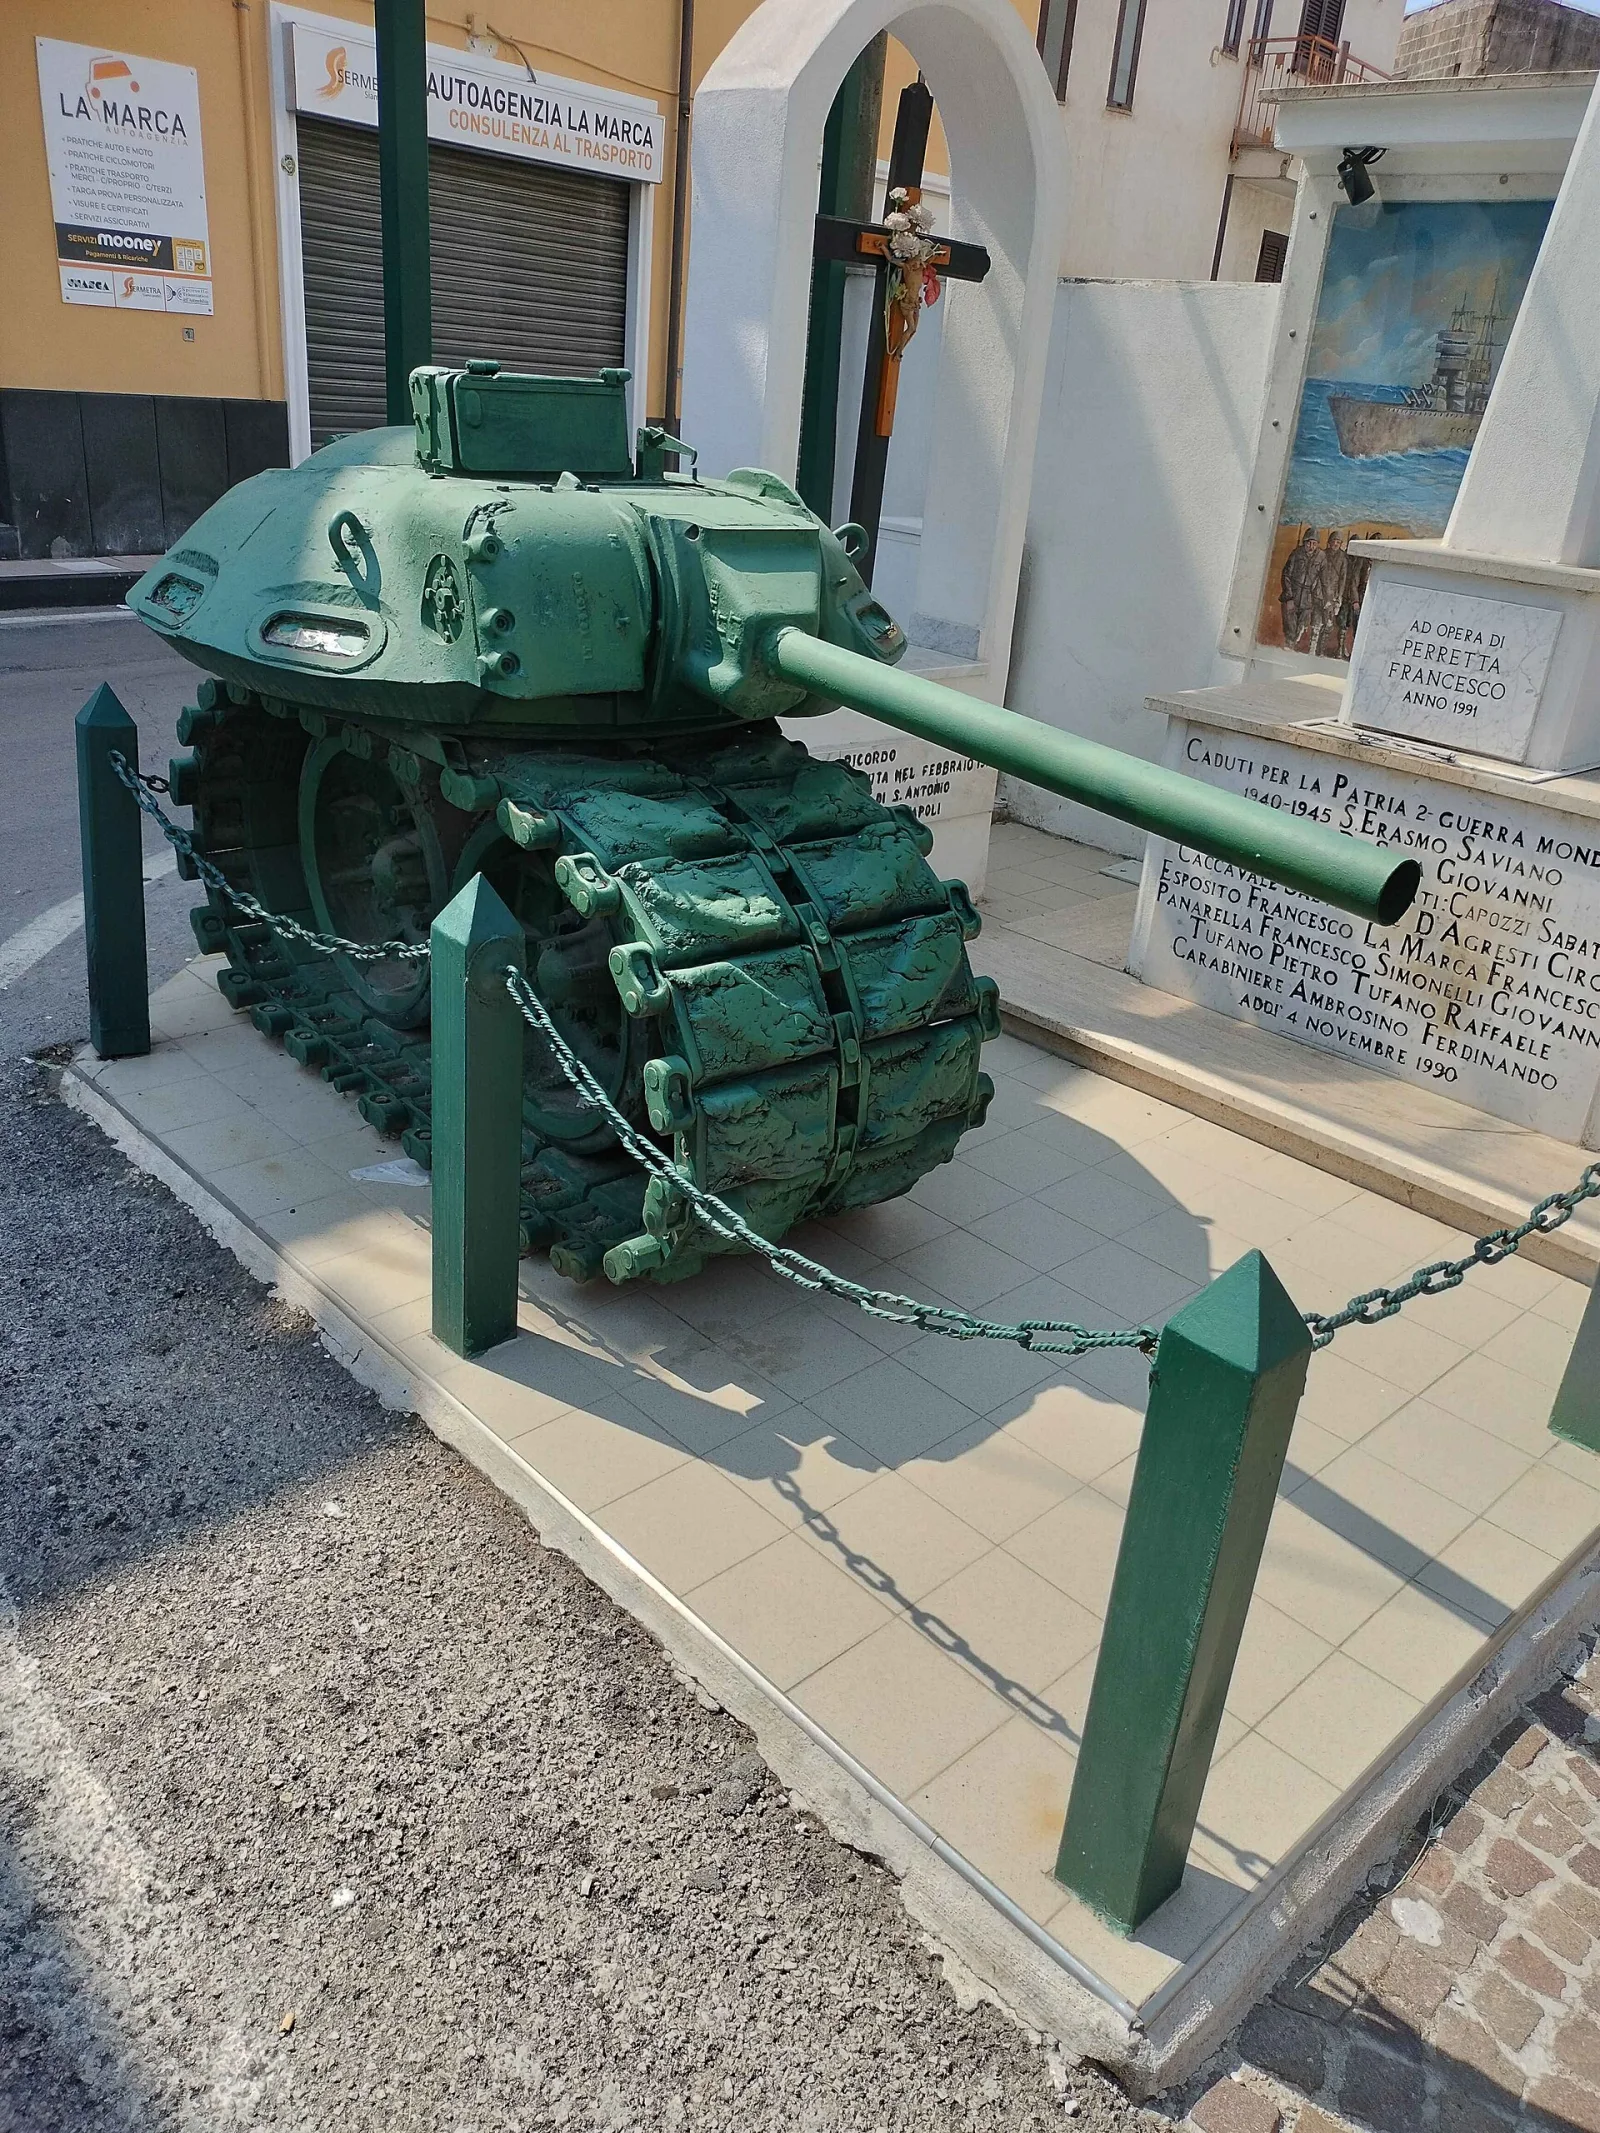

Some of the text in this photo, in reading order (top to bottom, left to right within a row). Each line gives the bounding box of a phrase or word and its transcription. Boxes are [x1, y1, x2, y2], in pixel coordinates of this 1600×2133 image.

[60, 92, 187, 138] LA MARCA
[427, 72, 654, 149] AUTOAGENZIA LA MARCA
[66, 135, 154, 157] PRATICHE AUTO E MOTO
[105, 126, 189, 147] AUTOAGENZIA
[449, 108, 653, 171] CONSULENZA AL TRASPORTO
[68, 149, 155, 170] PRATICHE CICLOMOTORI
[69, 163, 150, 183] PRATICHE TRASPORTO
[71, 173, 95, 184] MERCI
[100, 177, 141, 190] C/PROPRIO
[145, 183, 173, 194] C/TERZI
[71, 185, 184, 208] TARGA PROVA PERSONALIZZATA
[72, 199, 100, 210] VISURE
[106, 204, 149, 216] CERTIFICATI
[74, 212, 150, 229] SERVIZI ASSICURATIVI
[67, 234, 97, 245] SERVIZI
[97, 232, 162, 257] mooney
[85, 249, 117, 260] Pagamenti
[1410, 620, 1506, 649] AD OPERA DI
[1402, 639, 1501, 674] PERRETTA
[1388, 662, 1506, 700] FRANCESCO
[1402, 690, 1478, 718] ANNO 1991
[895, 766, 915, 783] NEL
[922, 759, 974, 777] FEBBRAIO
[1187, 738, 1254, 775] CADUTI
[1261, 764, 1290, 785] PER
[1299, 774, 1321, 794] LA
[1332, 773, 1406, 817] PATRIA
[1438, 811, 1524, 848] GUERRA
[912, 802, 941, 818] APOLI
[1244, 787, 1332, 824] 1940-1945
[1457, 835, 1563, 886] SAVIANO
[1436, 858, 1554, 914] GIOVANNI
[1159, 858, 1241, 904] ESPOSITO
[1247, 885, 1353, 940] FRANCESCO
[1363, 921, 1390, 951] LA
[1400, 933, 1478, 981] MARCA
[1157, 880, 1252, 934] PANARELLA
[1259, 915, 1366, 969] FRANCESCO
[1374, 952, 1484, 1009] SIMONELLI
[1190, 915, 1552, 1061] TUFANO PIETRO TUFANO RAFFAELE
[1172, 936, 1558, 1091] CARABINIERE AMBROSINO FERDINANDO
[1286, 1010, 1298, 1024] 4
[1306, 1015, 1408, 1065] NOVEMBRE
[1416, 1055, 1458, 1083] 1990
